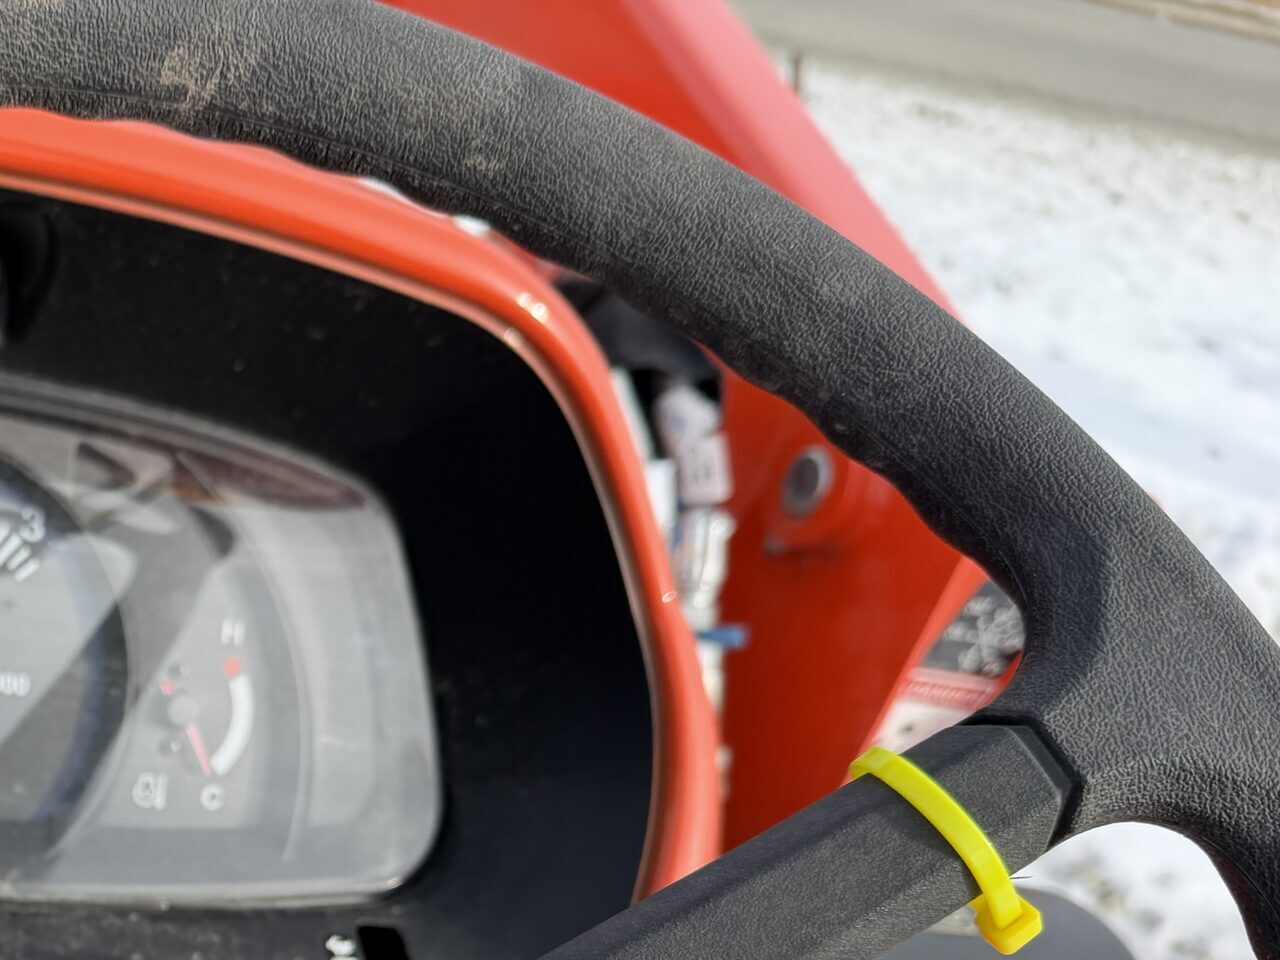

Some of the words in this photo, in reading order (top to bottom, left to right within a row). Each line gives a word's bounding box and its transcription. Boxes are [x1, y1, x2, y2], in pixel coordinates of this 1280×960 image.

[20, 506, 46, 543] 3
[221, 617, 246, 647] H
[200, 783, 225, 811] C
